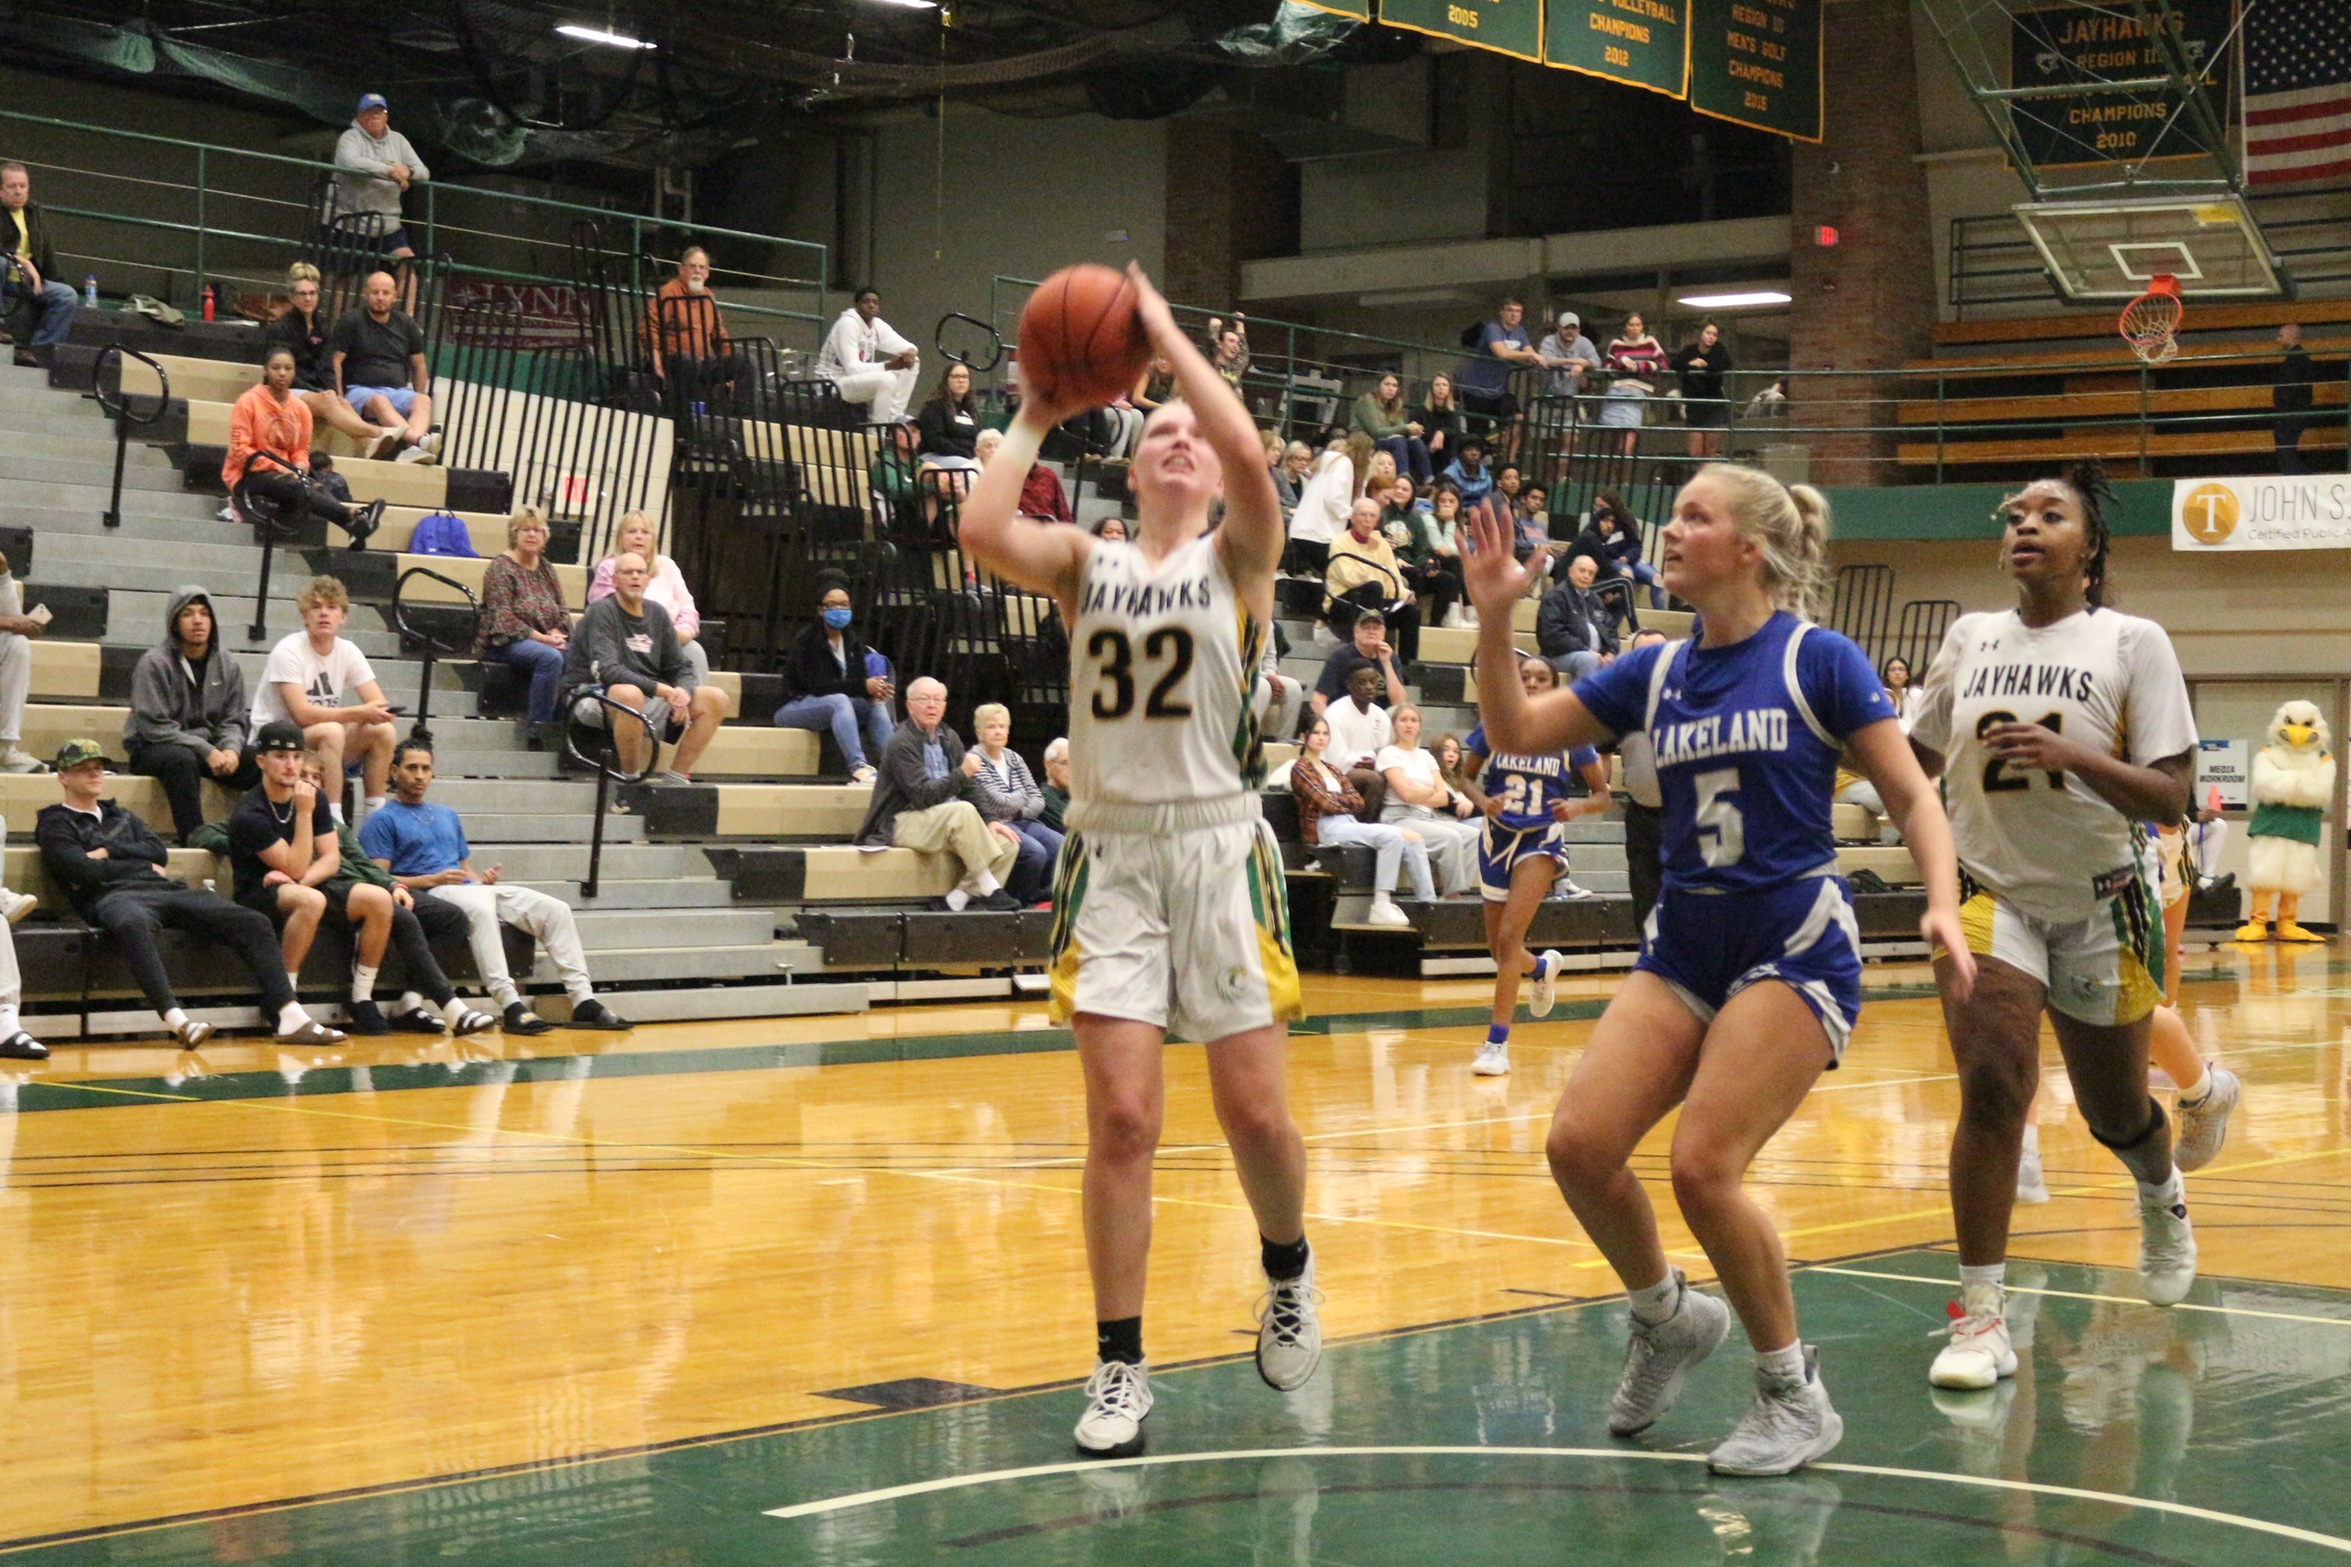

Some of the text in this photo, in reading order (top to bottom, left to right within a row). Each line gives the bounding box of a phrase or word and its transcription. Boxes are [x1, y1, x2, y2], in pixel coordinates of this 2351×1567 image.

[1448, 4, 1479, 28] 2005
[1589, 12, 1651, 44] CHAMPIONS
[1604, 45, 1630, 67] 2012
[2077, 50, 2136, 69] REGION
[1728, 59, 1784, 89] CHAMPIONS
[2069, 102, 2168, 125] CHAMPIONS
[2096, 131, 2137, 149] 2010
[2249, 485, 2318, 522] JOHN
[1080, 576, 1211, 618] JAYHAWKS
[1087, 625, 1195, 721] 32
[1963, 664, 2092, 702] JAYHAWKS
[1654, 707, 1789, 769] LAKELAND
[1496, 753, 1561, 777] LAKELAND
[2199, 775, 2245, 783] WORKROOM
[2209, 765, 2235, 774] MEDIA
[1503, 773, 1544, 816] 21
[1694, 766, 1745, 868] 5
